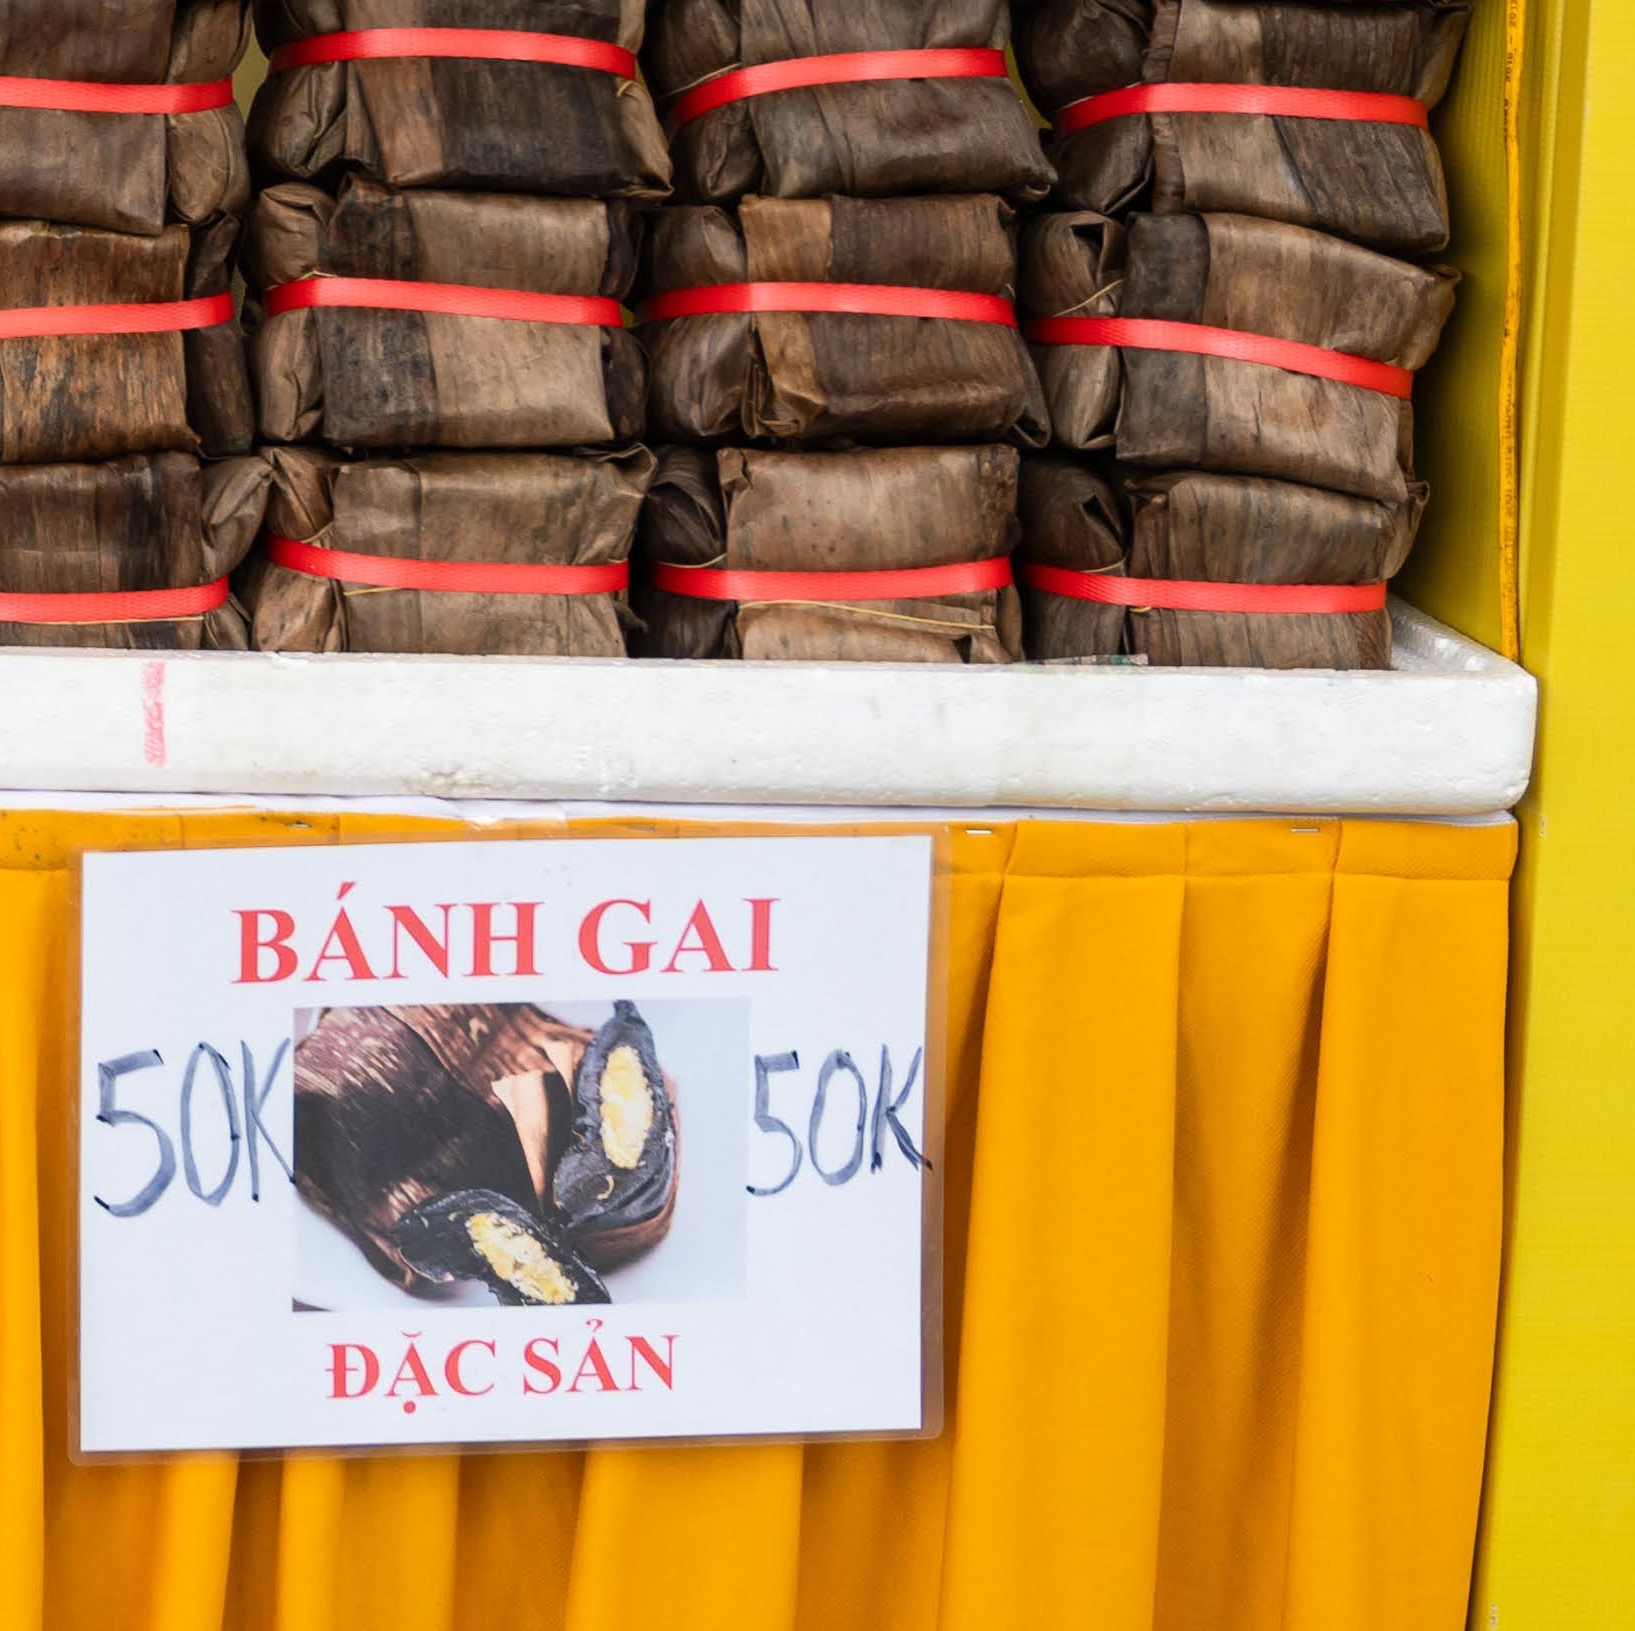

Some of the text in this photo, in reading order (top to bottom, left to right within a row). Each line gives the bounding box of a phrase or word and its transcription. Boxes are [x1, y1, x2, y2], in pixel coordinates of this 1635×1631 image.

[230, 881, 781, 986] BÁNH GAI
[93, 1036, 297, 1219] 50K
[746, 1043, 933, 1197] 50K
[325, 1318, 680, 1415] ĐẶC SẢN
